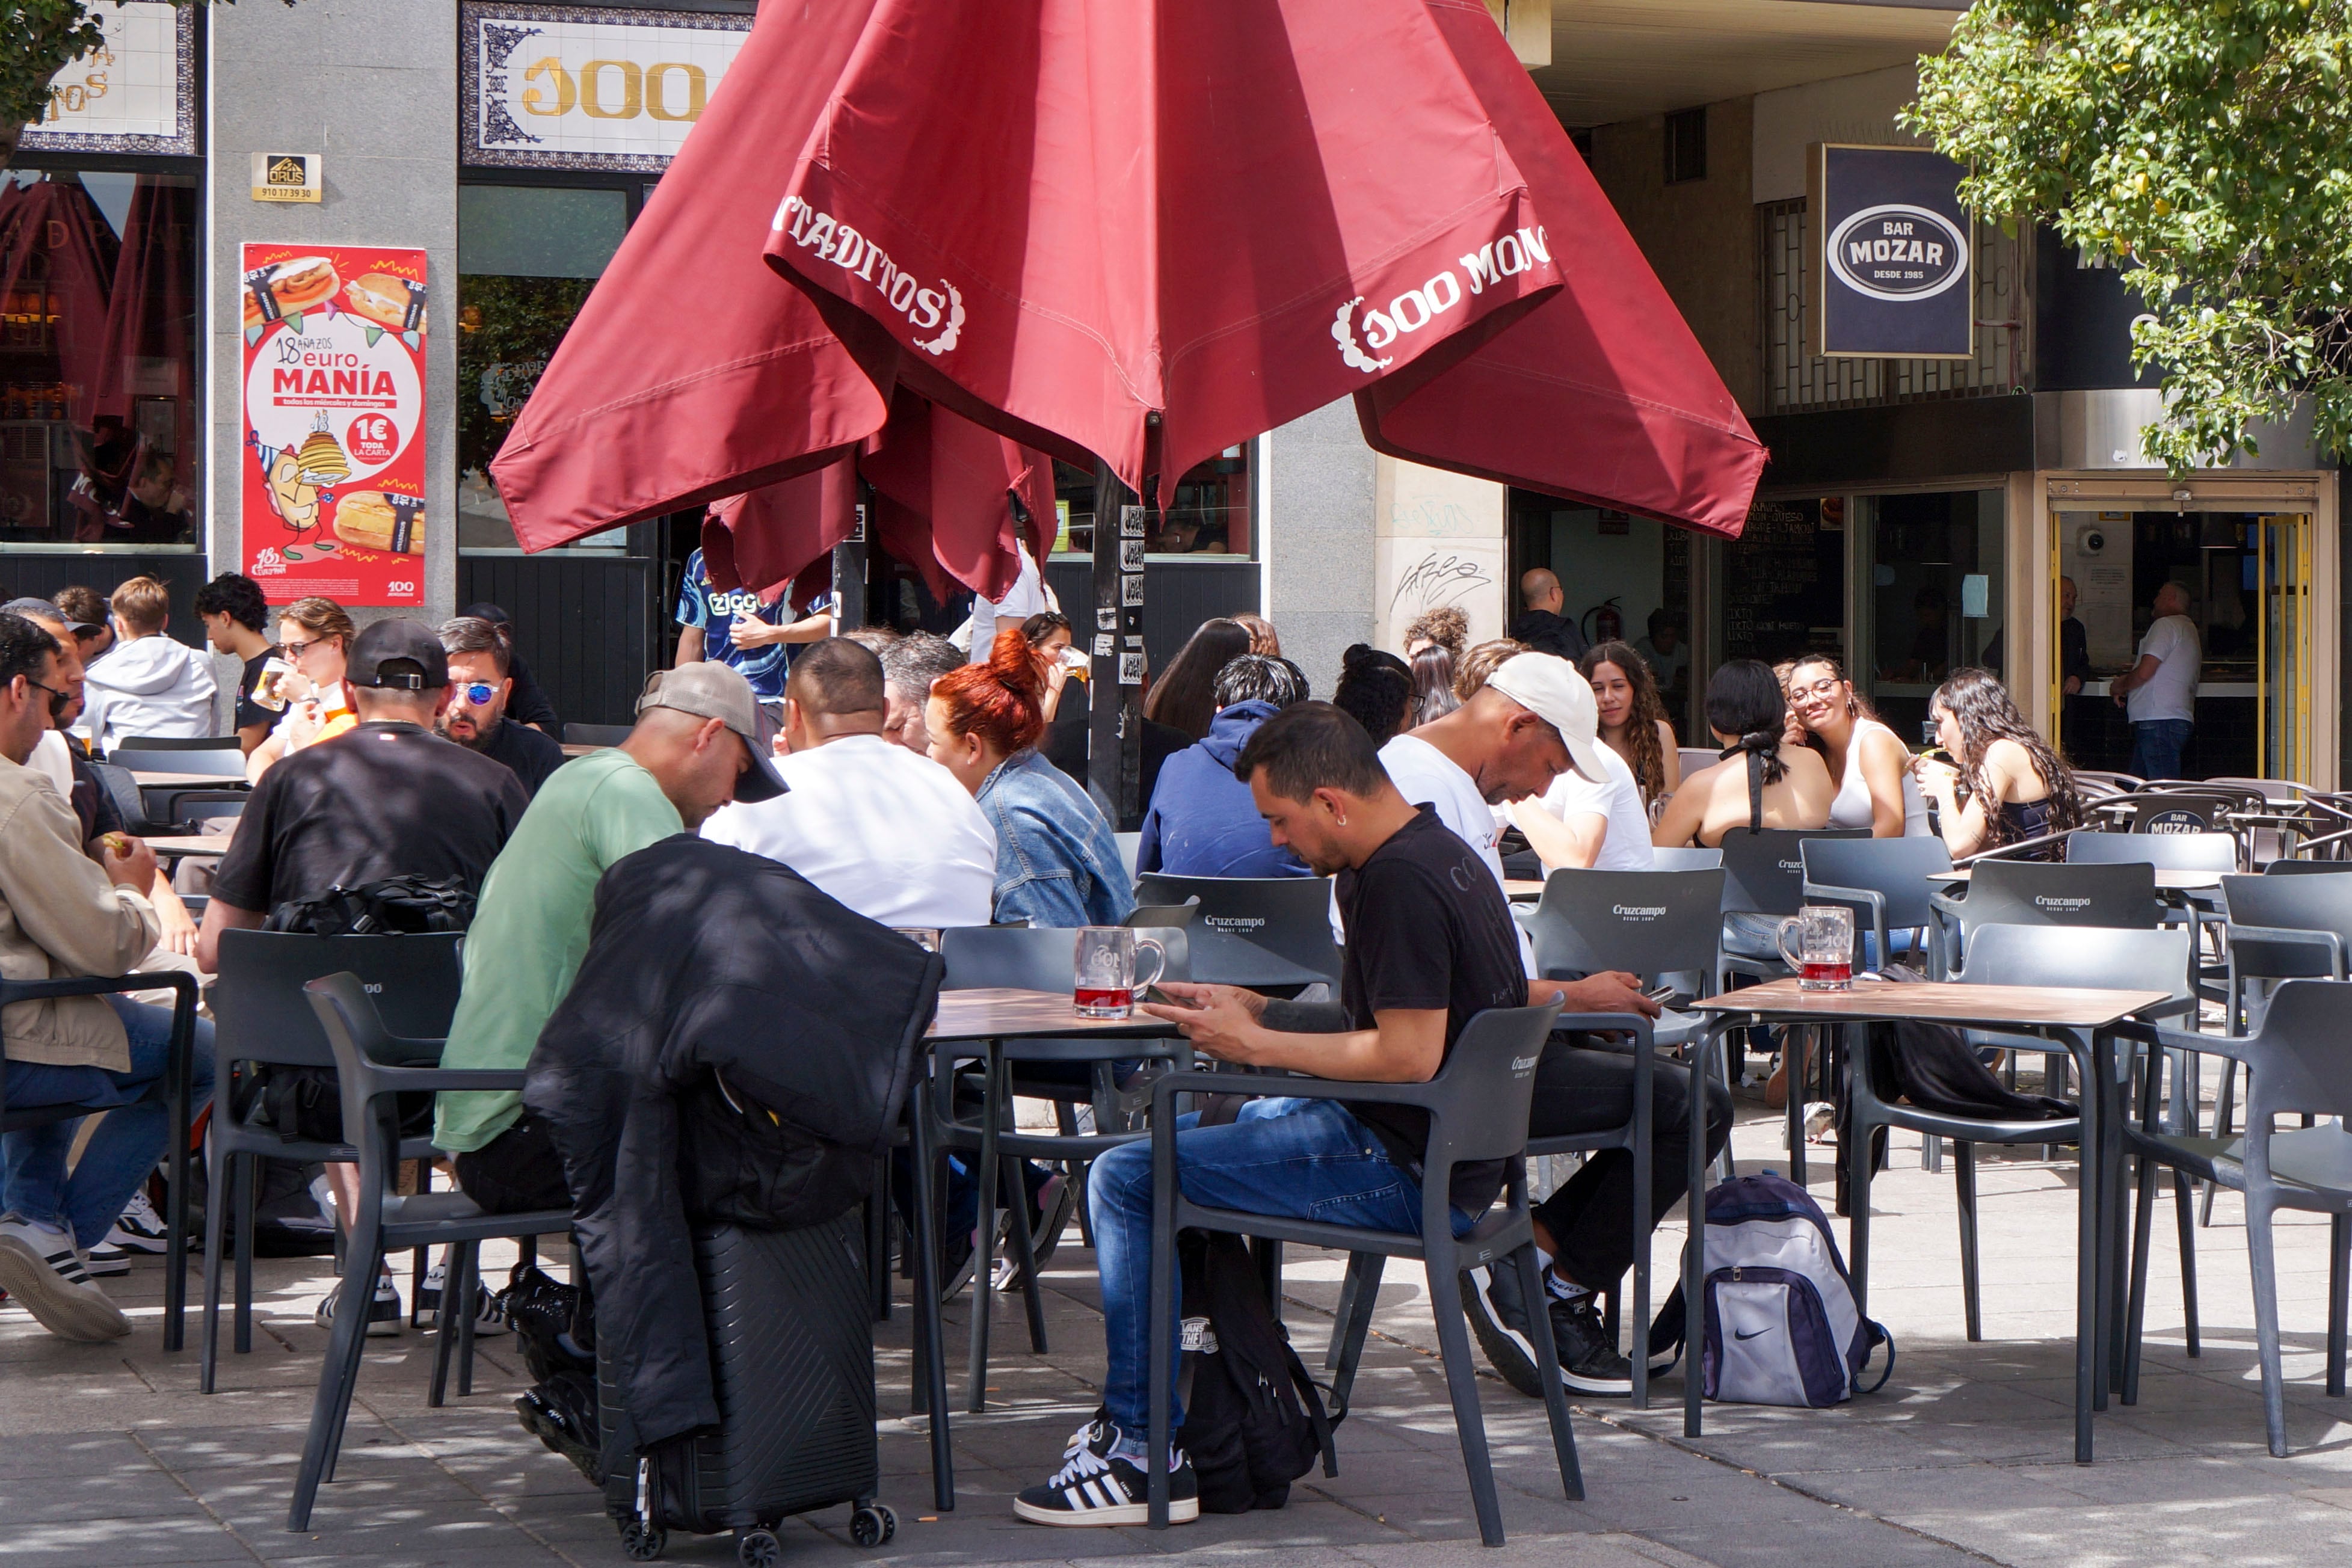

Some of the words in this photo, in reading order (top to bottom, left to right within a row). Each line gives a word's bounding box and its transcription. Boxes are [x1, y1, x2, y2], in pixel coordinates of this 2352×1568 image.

[269, 171, 304, 183] ORUS
[301, 189, 311, 198] 30
[1883, 221, 1913, 236] BAR
[1849, 239, 1944, 266] MOZAR
[1874, 269, 1901, 279] DESDE
[1904, 270, 1924, 280] 1985
[276, 337, 300, 364] 18
[298, 337, 332, 351] AÑAZOS
[303, 351, 359, 367] euro
[273, 364, 397, 396] MANÍA
[352, 400, 386, 408] domingos
[356, 419, 387, 441] 1€
[387, 580, 415, 592] 100
[2035, 895, 2091, 908] Cruzcampo
[1613, 903, 1666, 917] Cruzcampo
[1204, 914, 1265, 928] Cruzcampo
[1181, 1323, 1206, 1333] VANS
[1182, 1332, 1199, 1345] THE
